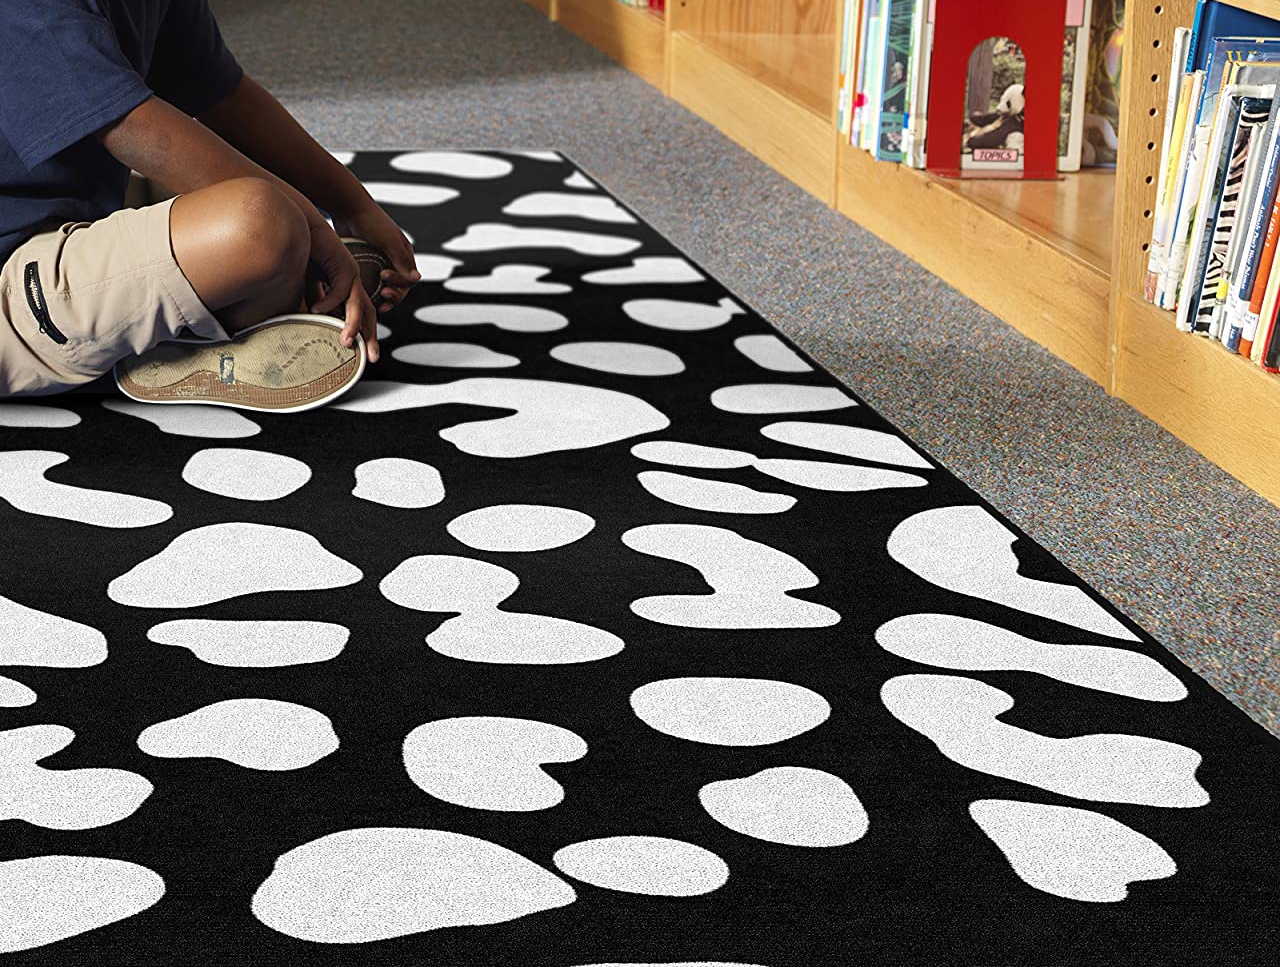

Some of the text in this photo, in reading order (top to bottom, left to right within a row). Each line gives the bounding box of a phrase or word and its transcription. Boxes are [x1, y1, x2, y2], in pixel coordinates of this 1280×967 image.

[980, 150, 1012, 161] TOPICS
[1254, 205, 1265, 231] Animals
[1266, 217, 1276, 240] EARLY
